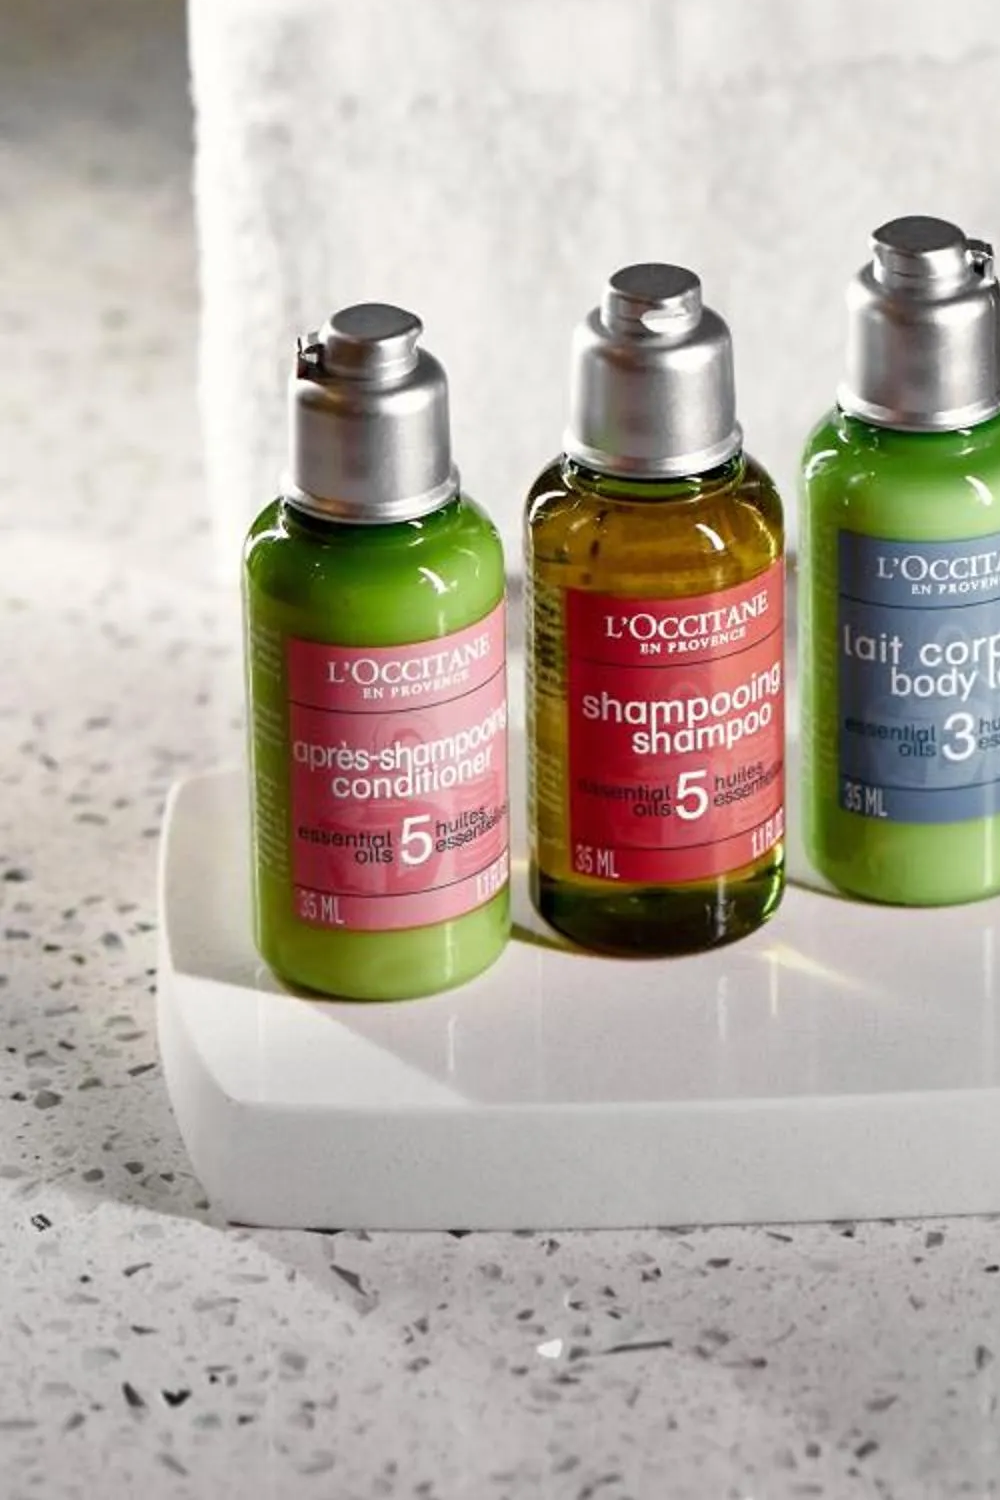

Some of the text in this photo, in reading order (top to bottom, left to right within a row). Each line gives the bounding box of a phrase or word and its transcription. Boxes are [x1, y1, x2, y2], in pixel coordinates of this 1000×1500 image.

[911, 583, 932, 596] EN
[606, 589, 769, 640] L'OCCITANE
[640, 626, 746, 655] EN PROVENCE
[844, 624, 903, 665] lait
[327, 632, 490, 685] L'OCCITANE
[363, 669, 470, 700] EN PROVENCE
[582, 661, 781, 729] shampooing
[891, 666, 978, 702] body
[632, 702, 772, 755] shampoo
[844, 718, 936, 743] essential
[942, 711, 976, 761] 3
[899, 741, 937, 758] oils
[331, 746, 492, 799] conditioner
[714, 761, 763, 789] huiles
[633, 800, 673, 817] oils
[674, 769, 709, 820] 5
[865, 786, 888, 817] ML
[298, 825, 393, 849] essential
[435, 806, 486, 838] huiles
[401, 814, 433, 865] 5
[355, 847, 394, 864] oils
[597, 848, 620, 879] ML
[321, 895, 345, 925] ML
